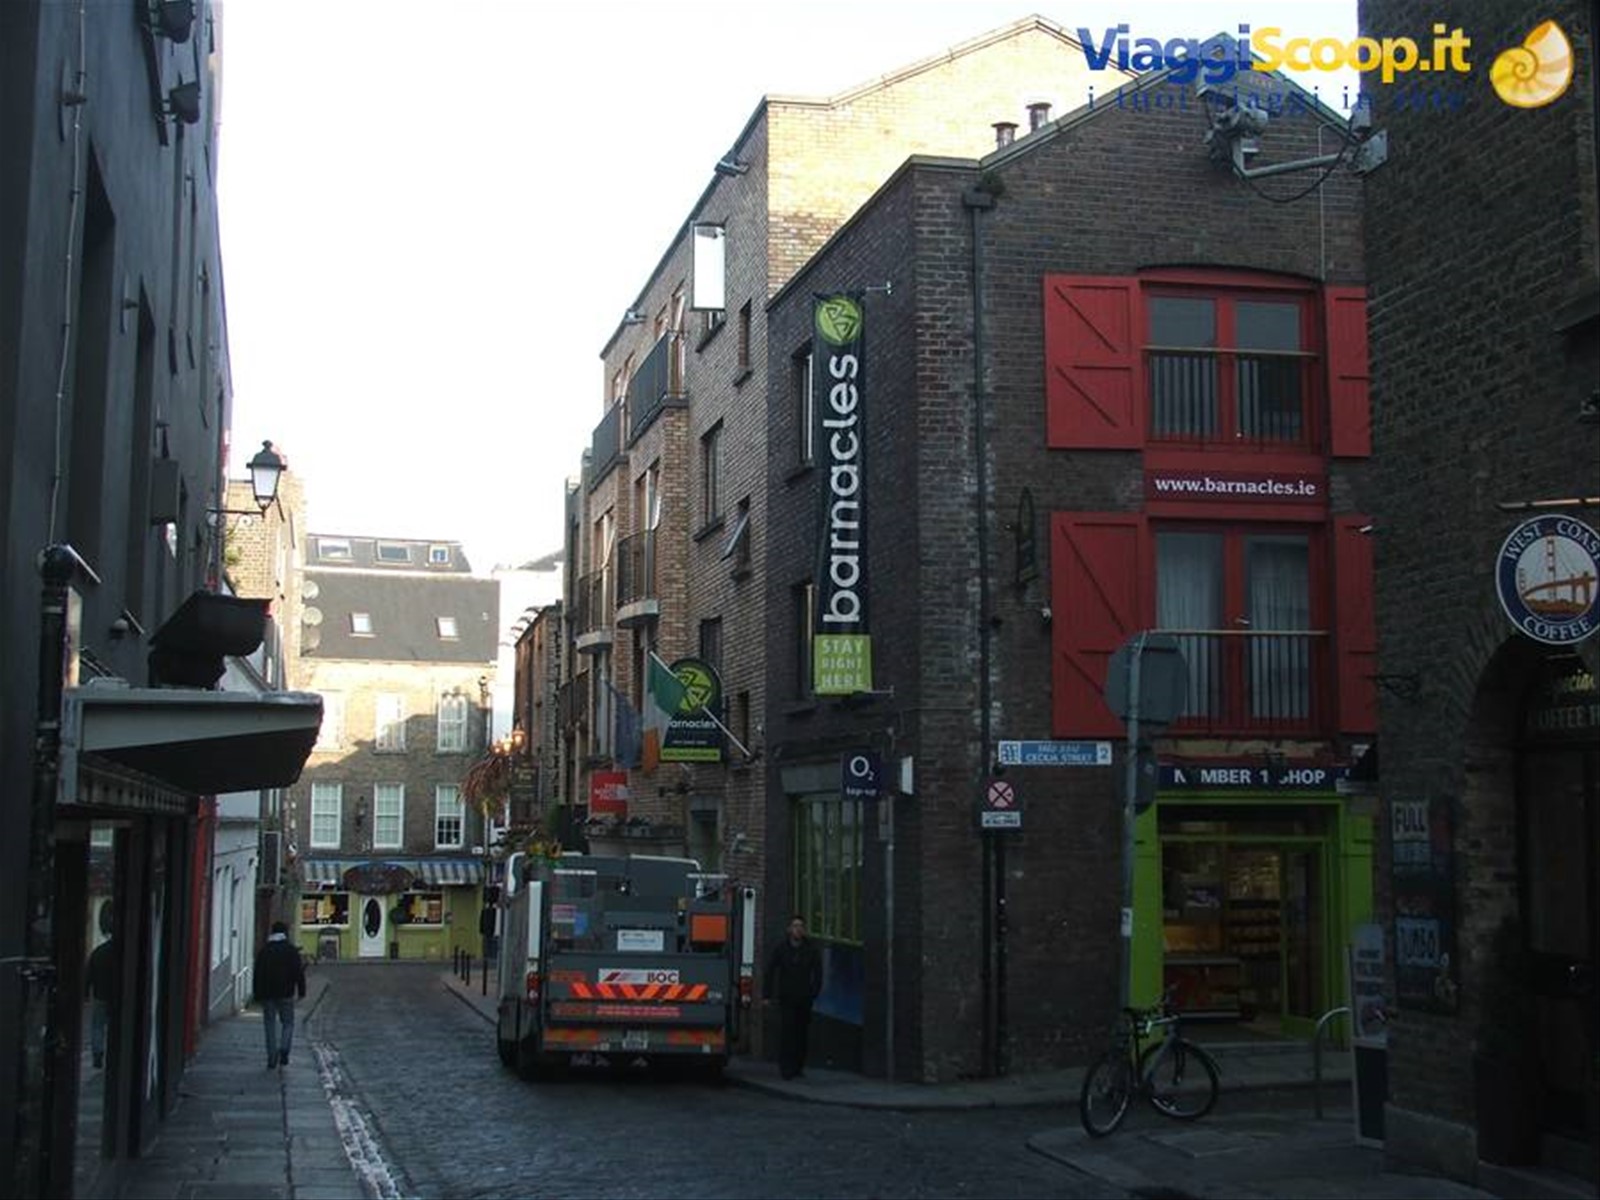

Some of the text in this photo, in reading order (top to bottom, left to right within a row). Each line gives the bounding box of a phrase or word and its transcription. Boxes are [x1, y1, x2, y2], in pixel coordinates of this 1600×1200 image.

[823, 354, 860, 624] barnacles
[1154, 477, 1317, 496] www.barnacles.ie
[1505, 521, 1543, 562] WEST
[1522, 616, 1592, 641] COFFEE
[822, 638, 864, 654] STAY
[1099, 747, 1109, 760] 2
[1174, 768, 1252, 785] NMBER
[646, 970, 680, 984] BOC
